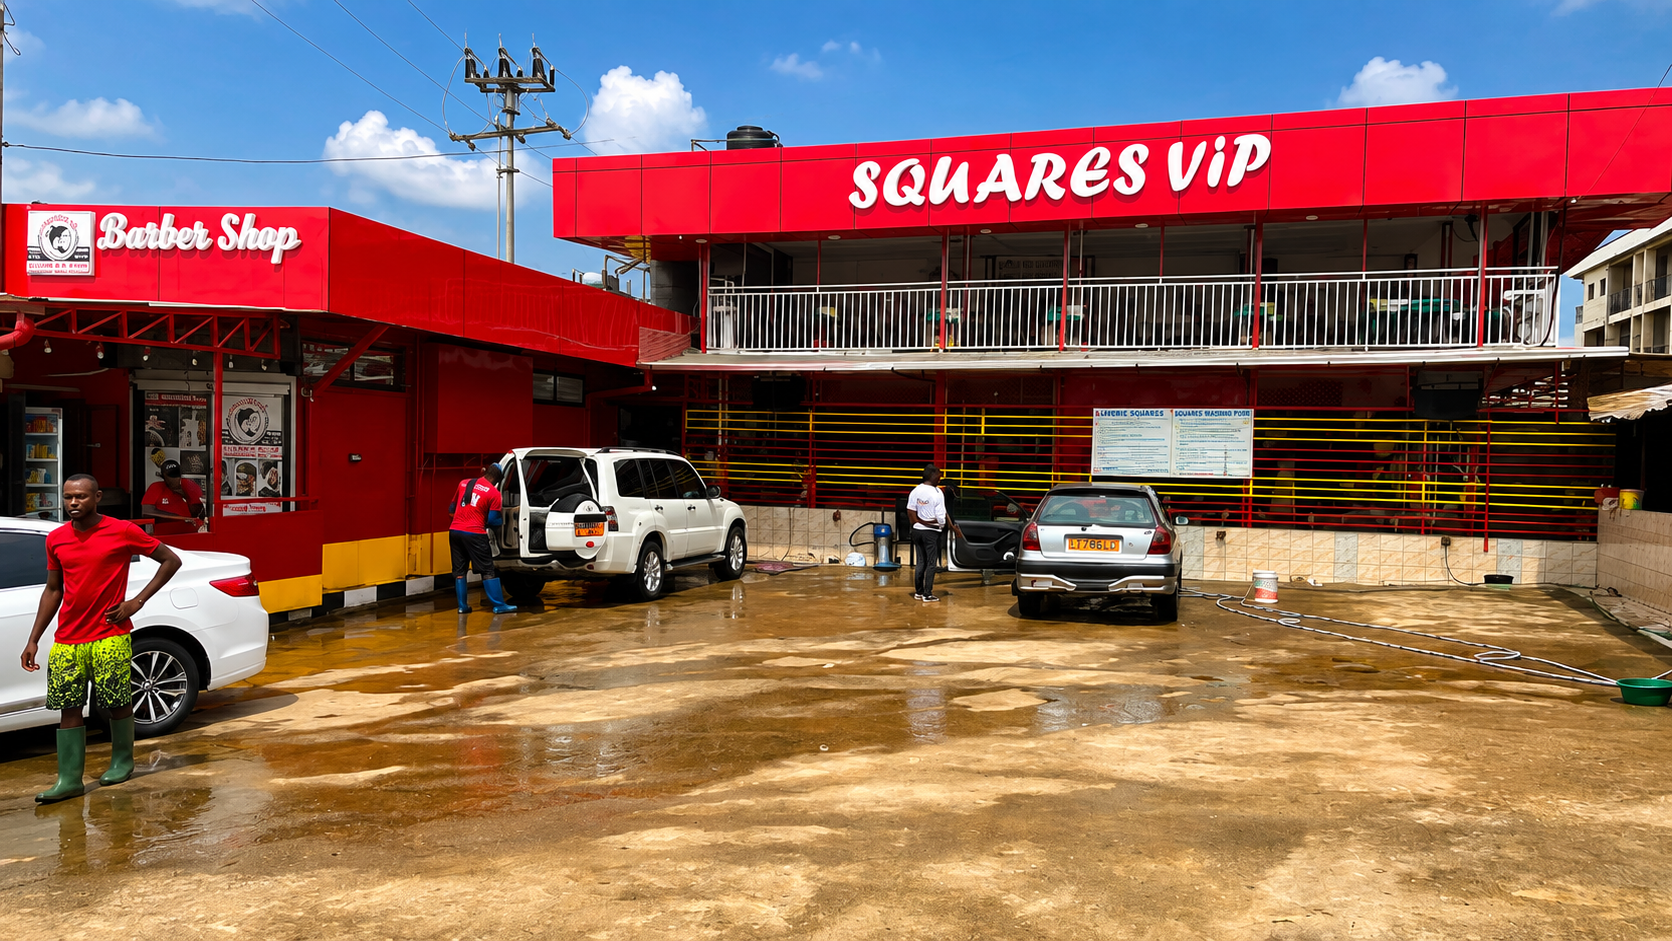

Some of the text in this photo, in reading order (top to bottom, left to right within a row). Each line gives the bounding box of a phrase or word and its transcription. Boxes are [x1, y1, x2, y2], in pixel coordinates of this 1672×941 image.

[849, 143, 1149, 210] SQUARES
[97, 212, 214, 250] Barber
[217, 212, 302, 265] Shop
